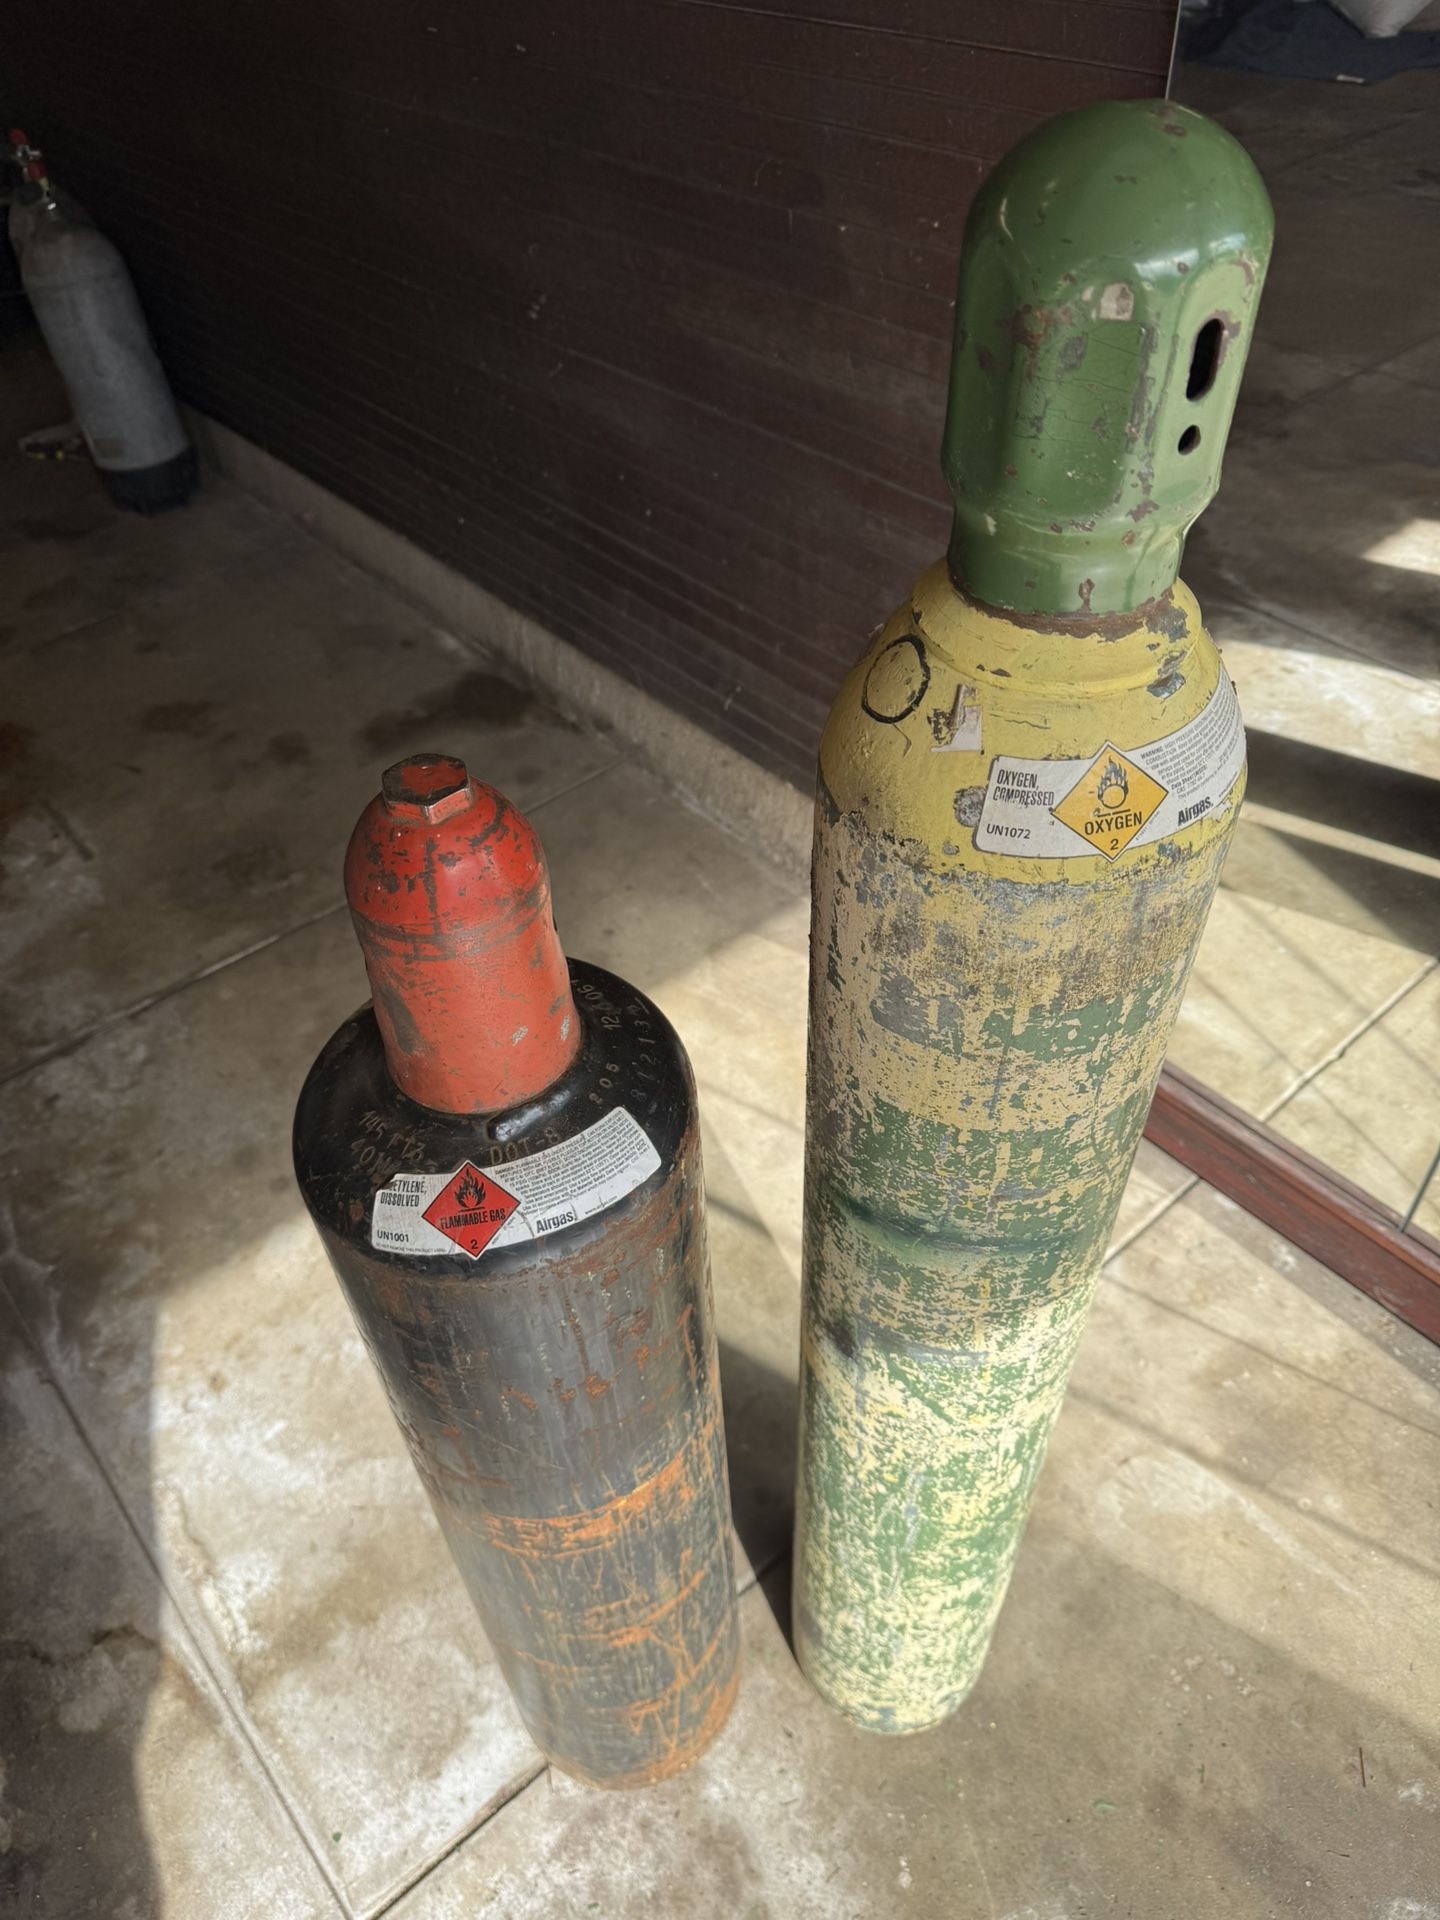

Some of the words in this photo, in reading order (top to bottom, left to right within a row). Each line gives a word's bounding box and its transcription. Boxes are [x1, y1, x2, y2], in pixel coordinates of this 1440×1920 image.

[996, 769, 1038, 789] OXYGEN,
[992, 786, 1055, 807] COMPRESSED
[986, 823, 1031, 840] UN1072
[1084, 811, 1143, 836] OXYGEN
[1110, 838, 1119, 851] 2
[381, 1192, 419, 1207] DISSOLVED
[440, 1212, 488, 1230] FLAMMABLE
[489, 1208, 506, 1223] GAS
[377, 1230, 409, 1243] UN1001
[470, 1239, 479, 1250] 2
